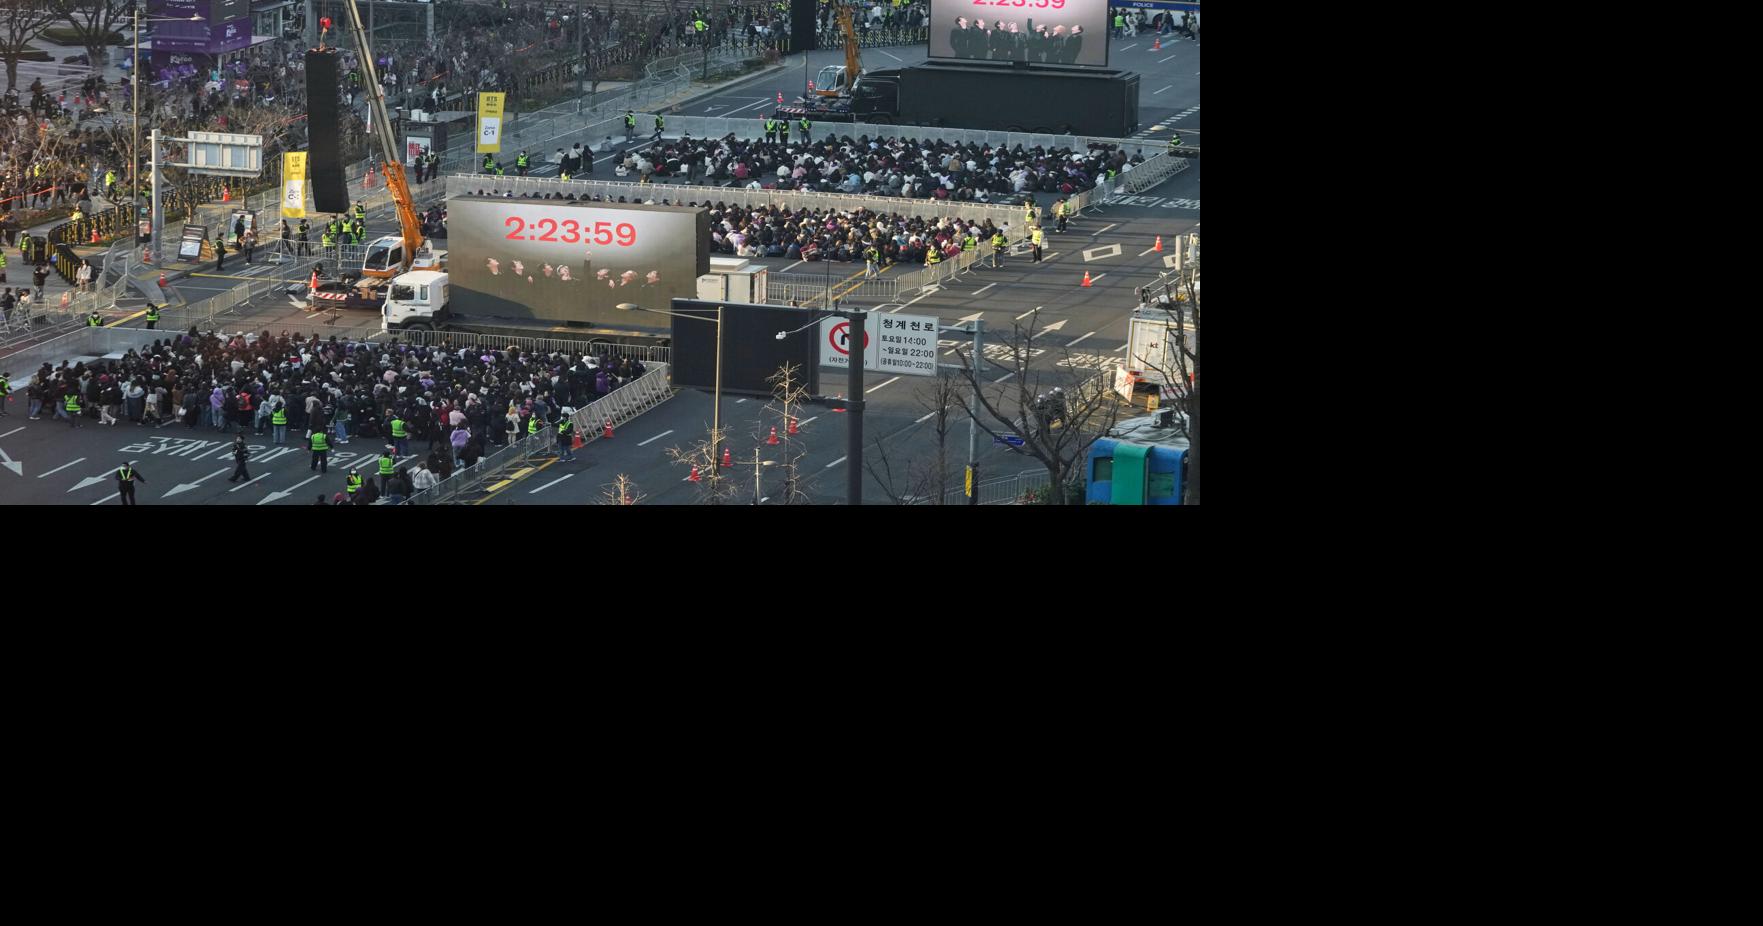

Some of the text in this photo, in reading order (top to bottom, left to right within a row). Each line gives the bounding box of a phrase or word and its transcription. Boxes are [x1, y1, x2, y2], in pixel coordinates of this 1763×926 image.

[504, 216, 637, 247] 2:23:59
[882, 318, 935, 332] 청계천로
[881, 335, 902, 344] 토요일
[882, 346, 934, 358] ~일요일 22:00
